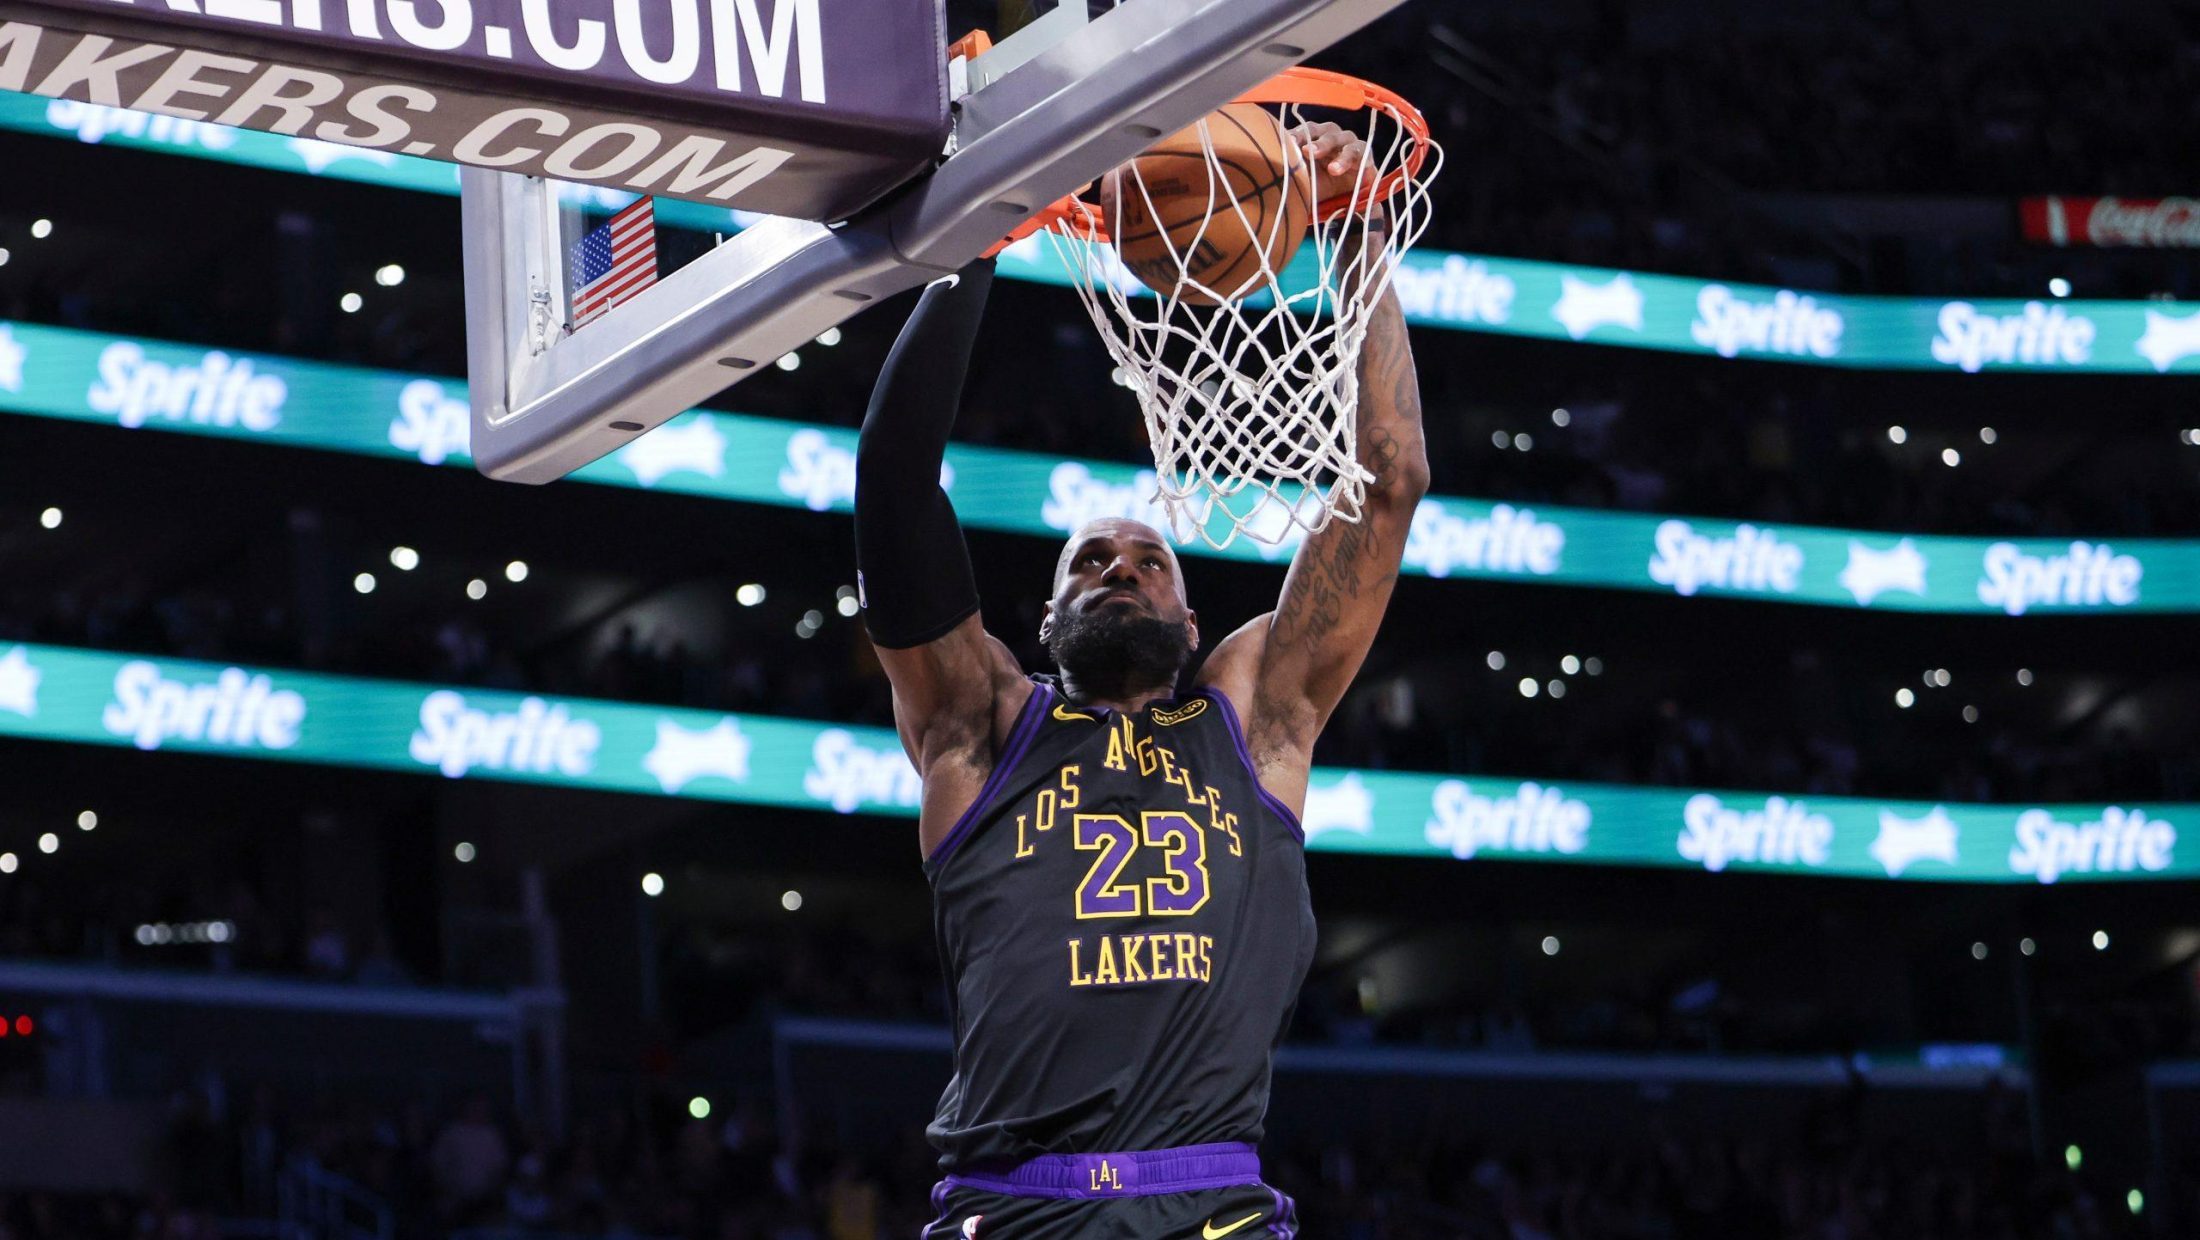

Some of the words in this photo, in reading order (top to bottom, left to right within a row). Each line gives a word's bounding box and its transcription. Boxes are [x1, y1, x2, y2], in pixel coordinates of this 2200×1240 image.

[1390, 253, 1516, 326] prite
[1691, 284, 1843, 358] Sprite
[1931, 301, 2097, 373] Sprite
[87, 342, 288, 430] Sprite
[1402, 500, 1565, 578] Sprite
[1648, 520, 1804, 597] Sprite
[1976, 541, 2143, 616] Sprite
[102, 661, 306, 750] Sprite
[410, 690, 601, 778] Sprite
[803, 727, 923, 814] Spr
[1014, 764, 1082, 859] LOS
[1103, 714, 1244, 858] ANGELES
[1424, 780, 1591, 859] Sprite
[1676, 794, 1834, 872] Sprite
[2008, 806, 2177, 884] Sprite
[1073, 811, 1211, 920] 23
[1067, 933, 1214, 987] LAKERS
[1089, 1159, 1123, 1191] LAL
